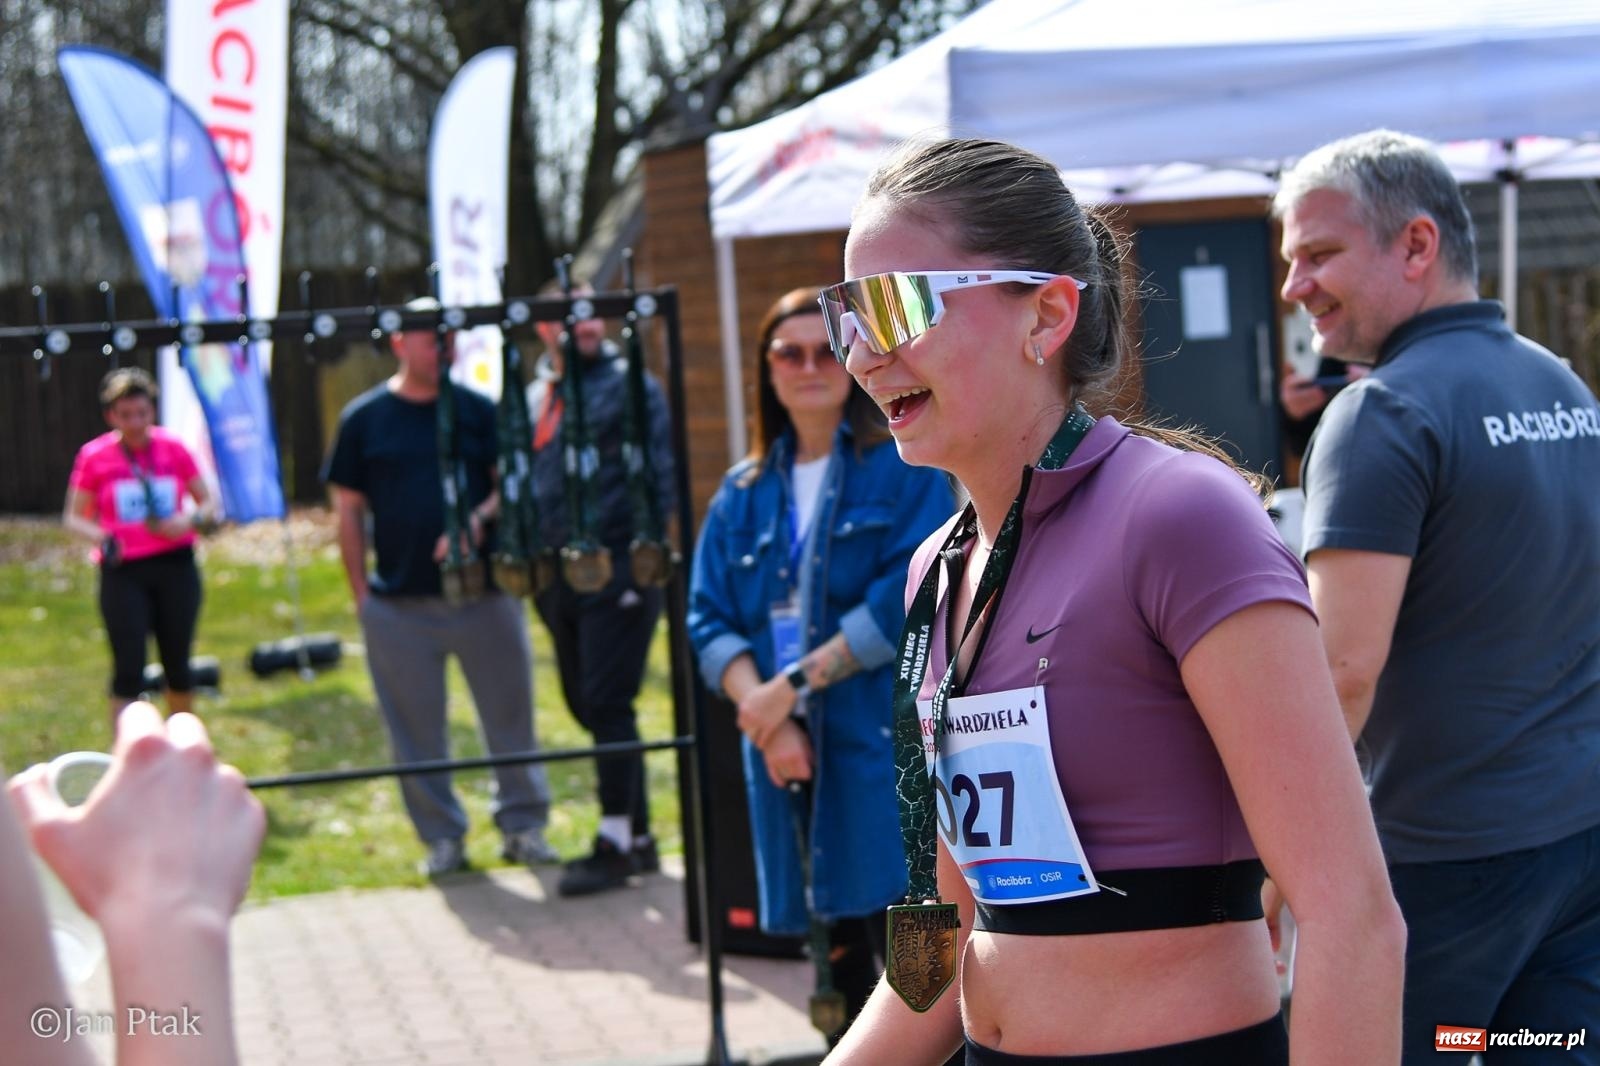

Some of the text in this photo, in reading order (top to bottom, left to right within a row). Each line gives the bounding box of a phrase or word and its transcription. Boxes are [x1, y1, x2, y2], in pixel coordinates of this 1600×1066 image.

[900, 632, 916, 680] XIV BIEG
[910, 624, 930, 693] TWARDZIELA
[942, 709, 1028, 736] WARDZIELA
[996, 871, 1062, 887] Racibórz OSiR
